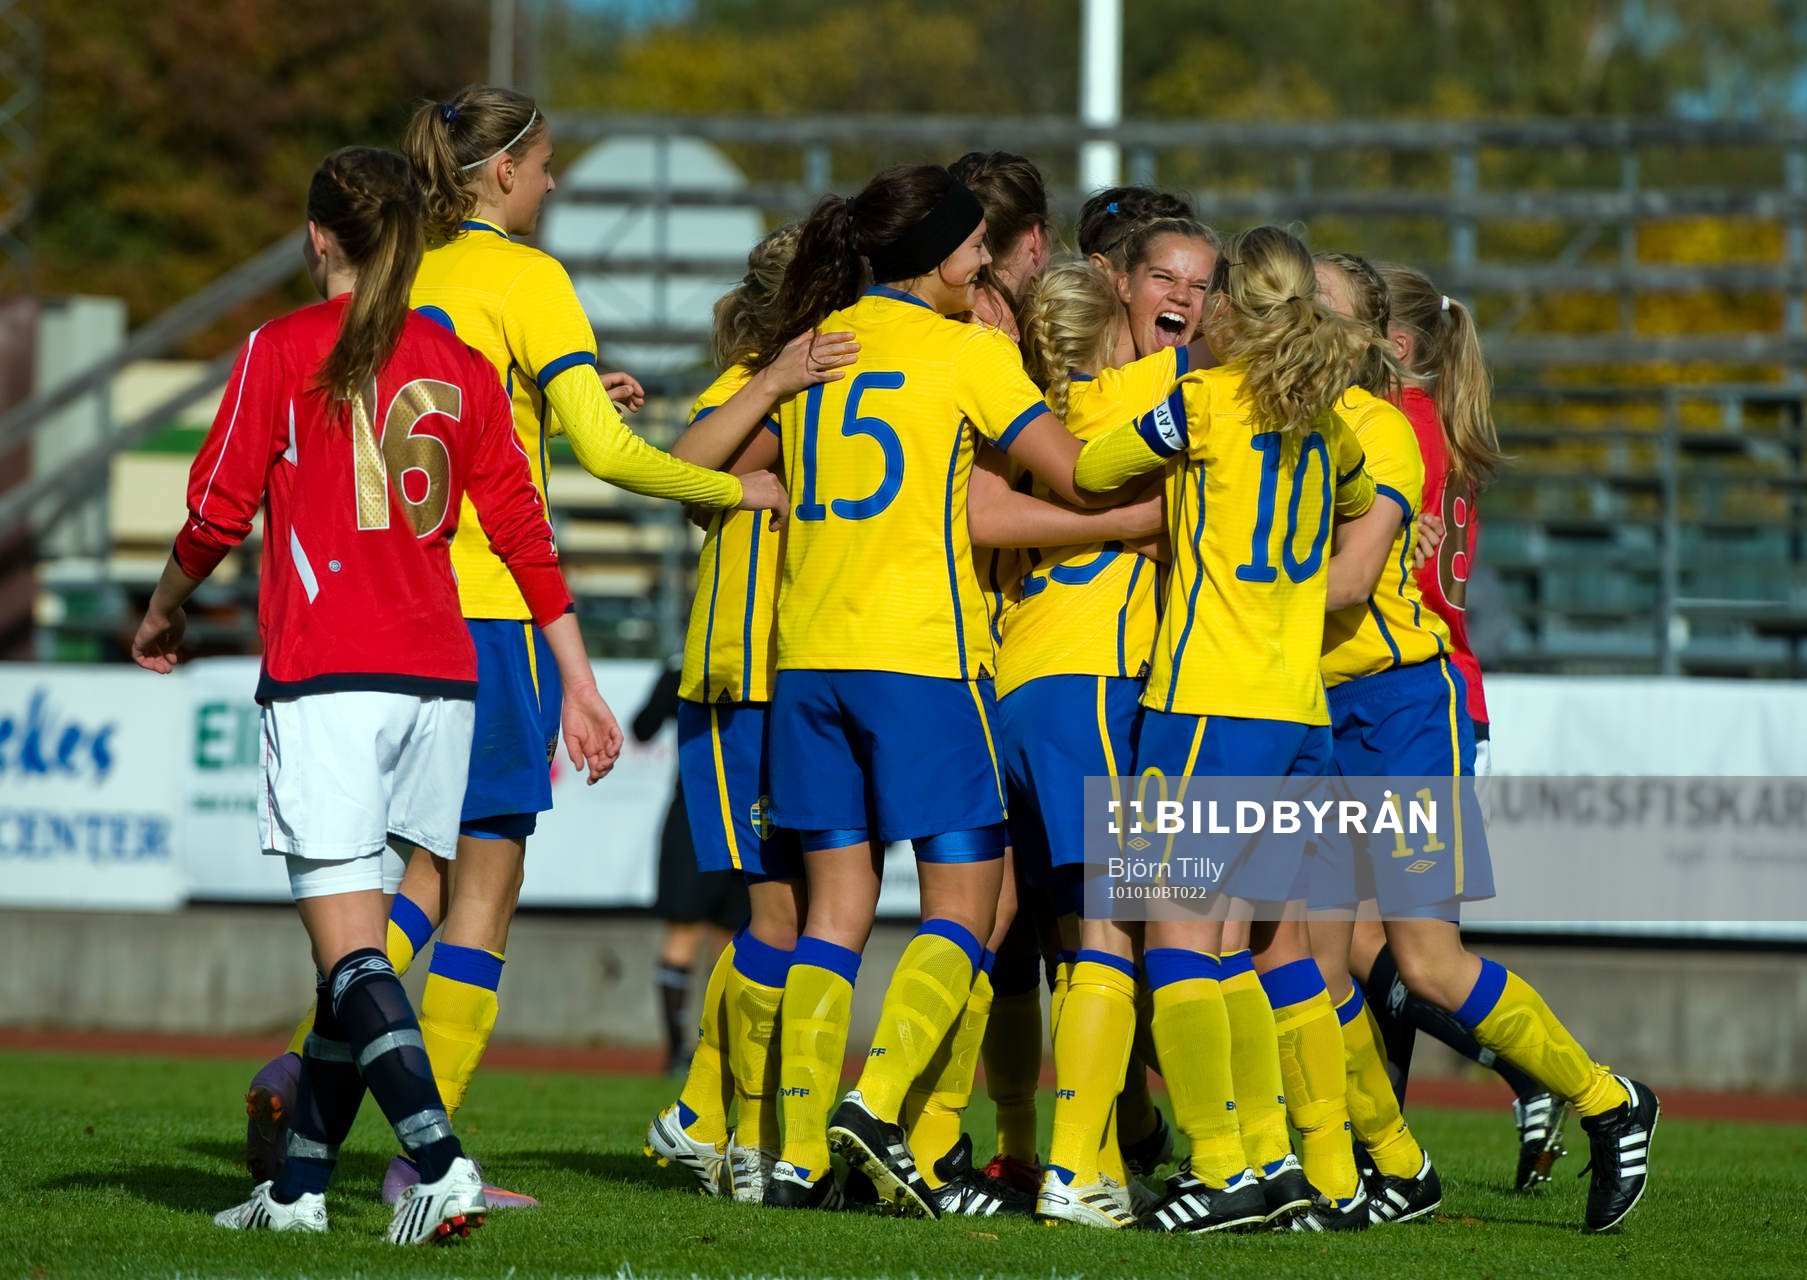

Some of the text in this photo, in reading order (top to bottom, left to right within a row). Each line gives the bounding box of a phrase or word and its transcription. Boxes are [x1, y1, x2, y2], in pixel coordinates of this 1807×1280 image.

[351, 377, 463, 539] 16
[795, 371, 905, 521] 15
[1236, 431, 1332, 583] 10
